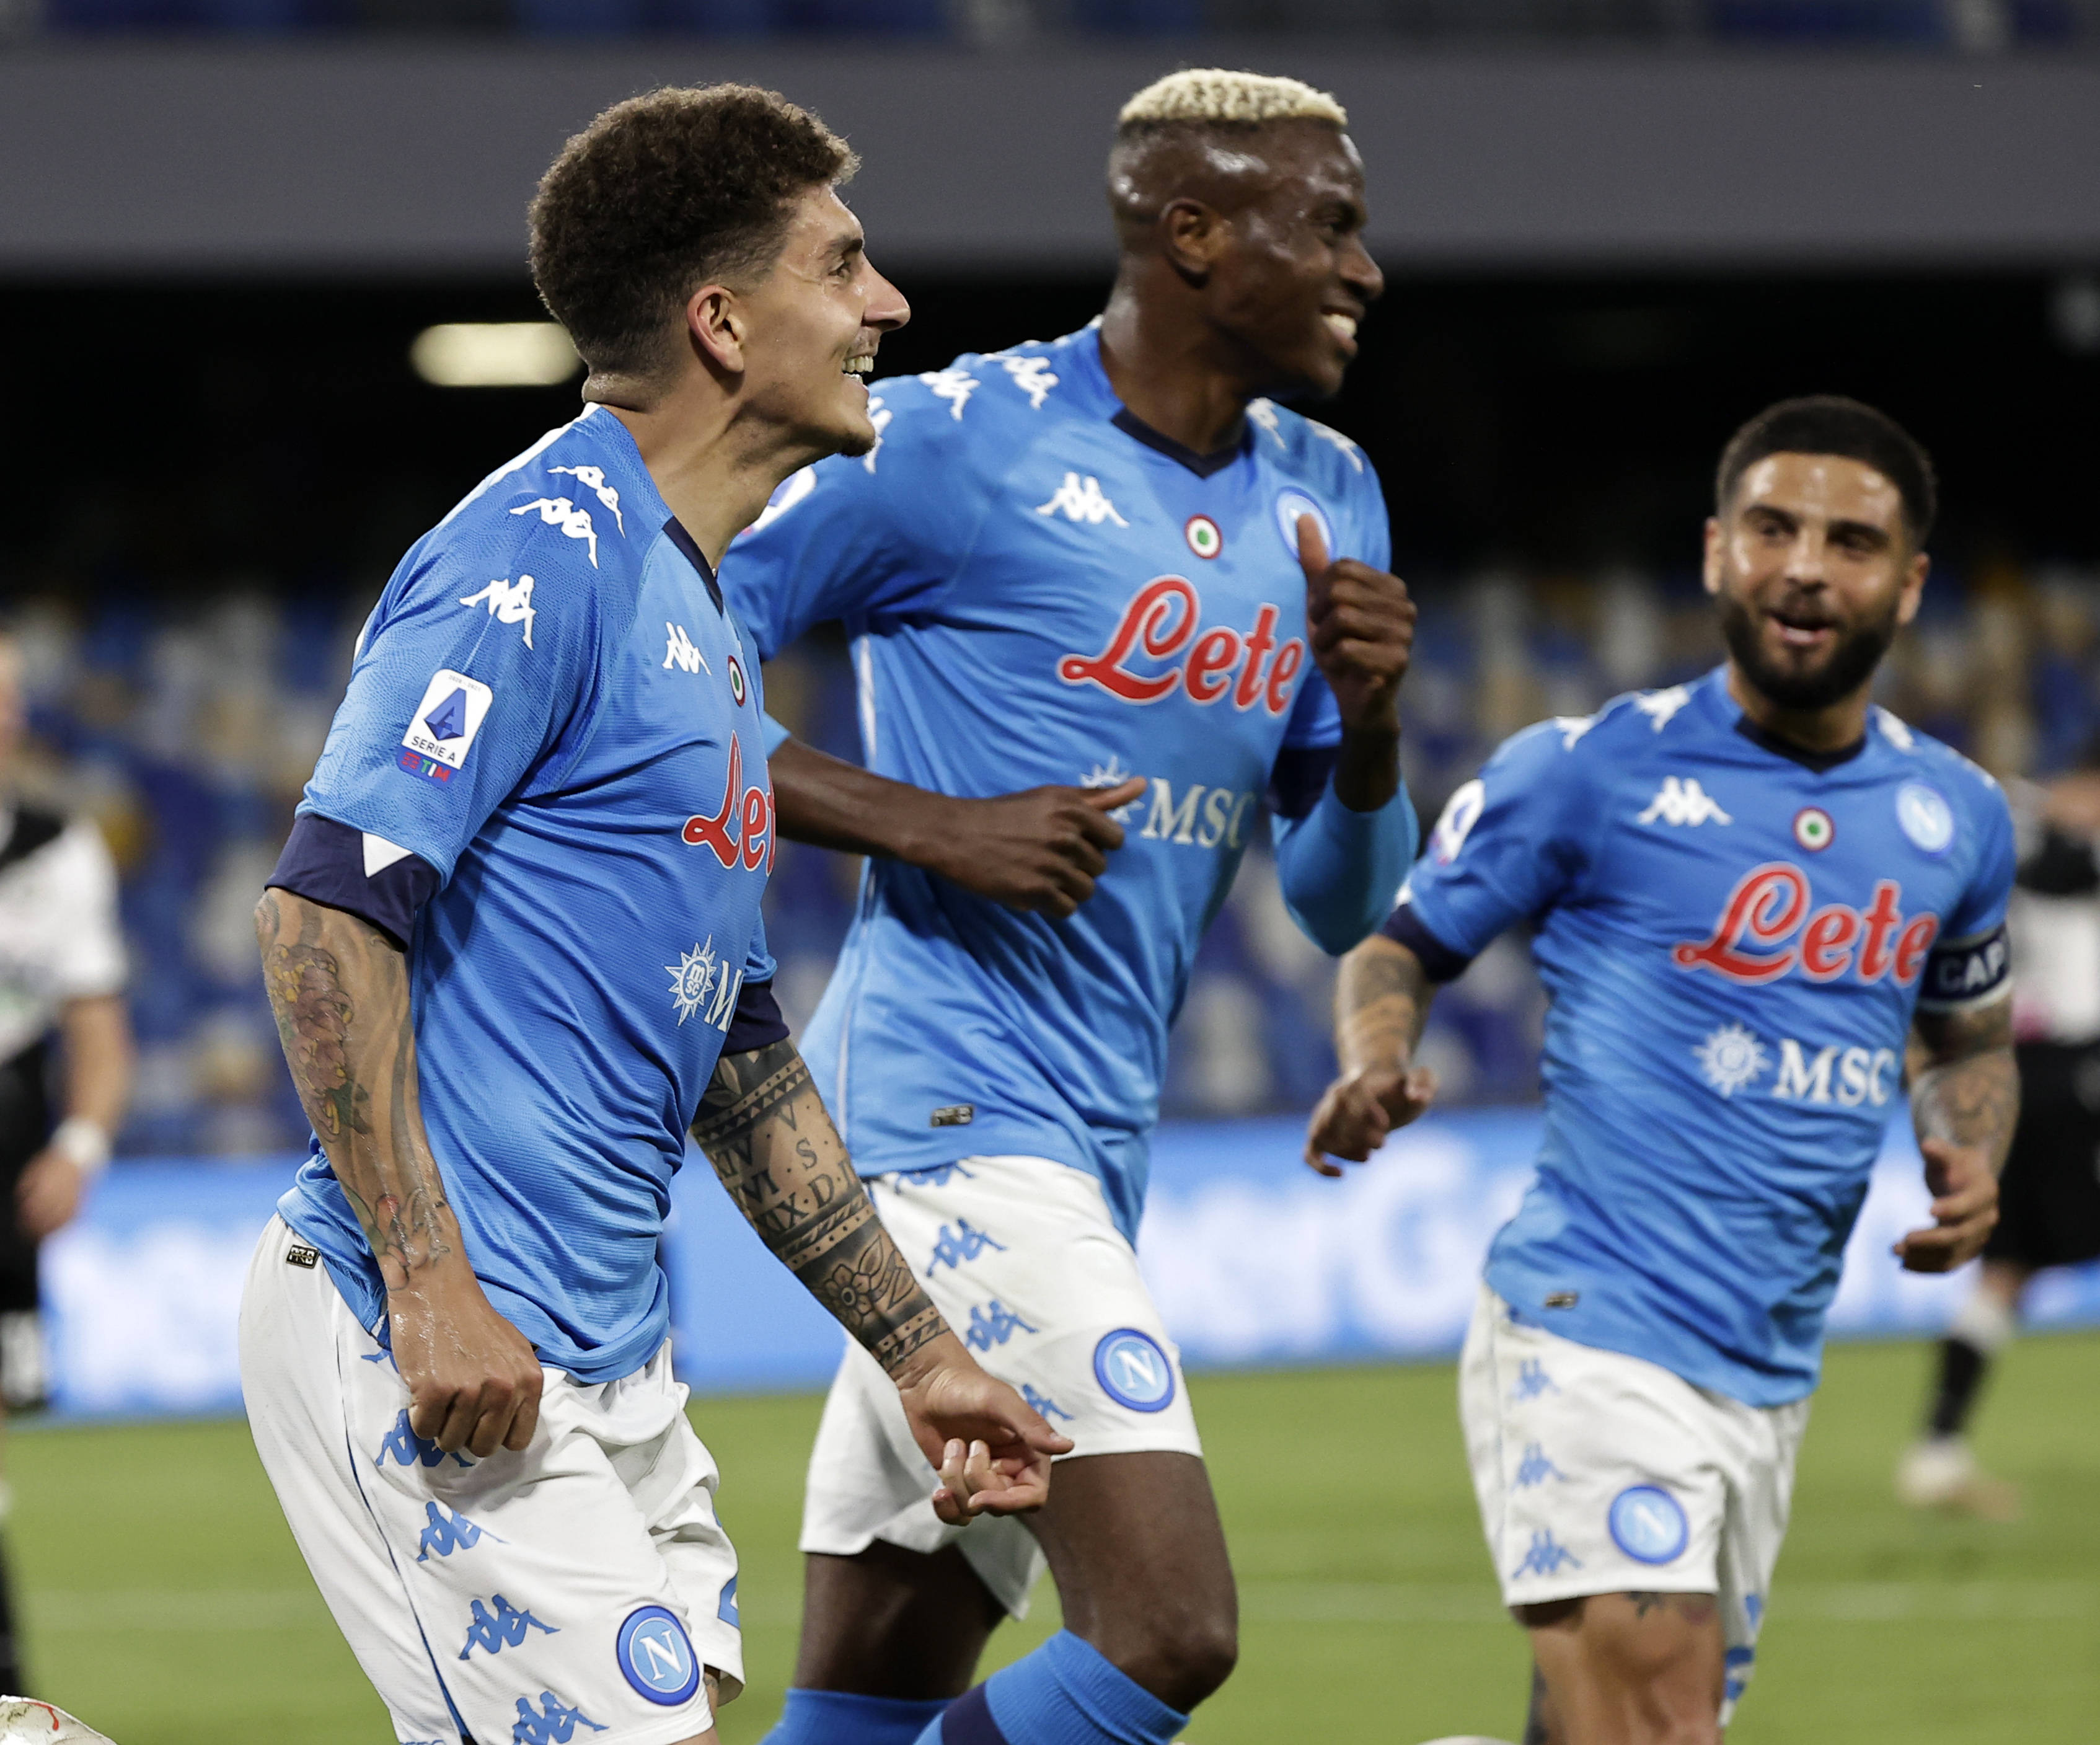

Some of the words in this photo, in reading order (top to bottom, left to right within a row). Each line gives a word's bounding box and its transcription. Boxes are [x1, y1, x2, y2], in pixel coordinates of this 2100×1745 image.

[1056, 573, 1305, 717] Lete
[411, 735, 447, 758] SERIE
[447, 752, 456, 763] A
[420, 758, 451, 783] TIM
[1672, 860, 1940, 988] Lete
[1771, 1037, 1895, 1108] MSC
[795, 1136, 818, 1170] S
[808, 1173, 834, 1209] D
[1116, 1350, 1157, 1389] N
[638, 1629, 684, 1682] N
